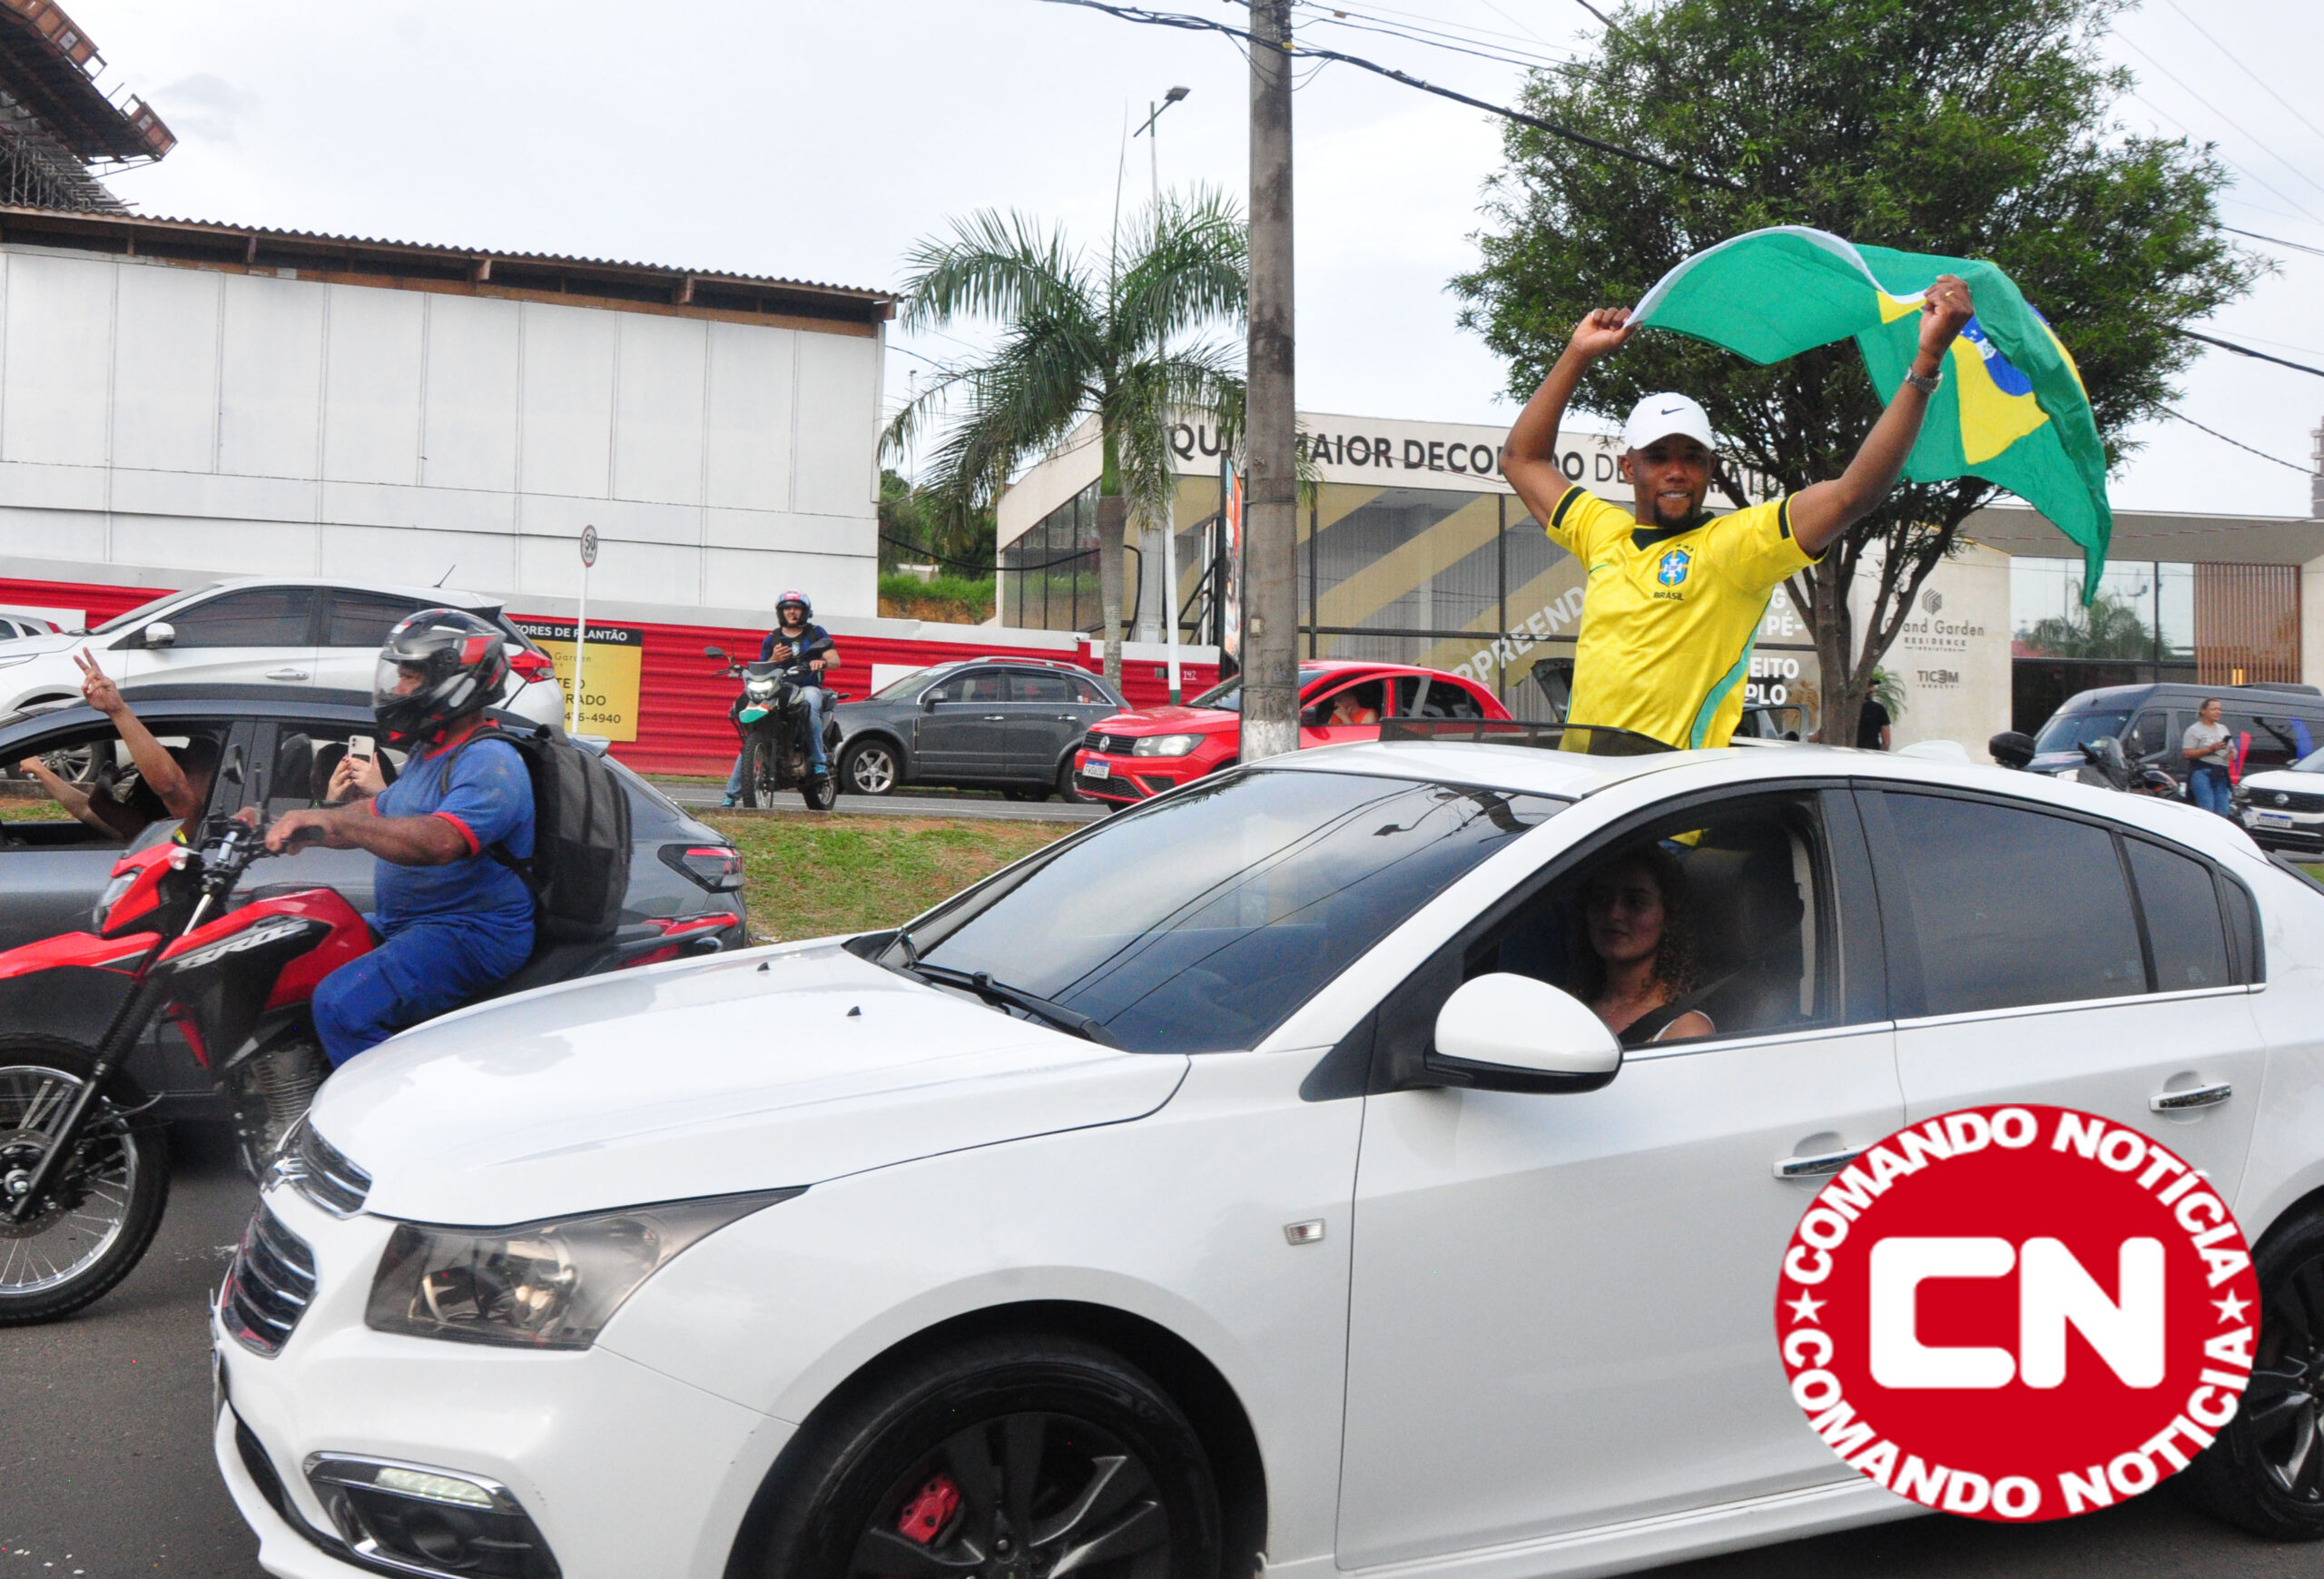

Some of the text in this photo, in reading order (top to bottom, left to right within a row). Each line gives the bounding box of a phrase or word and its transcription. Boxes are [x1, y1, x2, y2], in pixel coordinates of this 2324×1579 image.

[586, 534, 596, 550] 50
[1653, 592, 1685, 600] BRASIL
[555, 627, 571, 637] DE
[574, 628, 627, 641] PANTÃO
[1935, 619, 1984, 636] Garden
[1904, 637, 1966, 646] RESIDENCE
[564, 712, 621, 724] 46-4940
